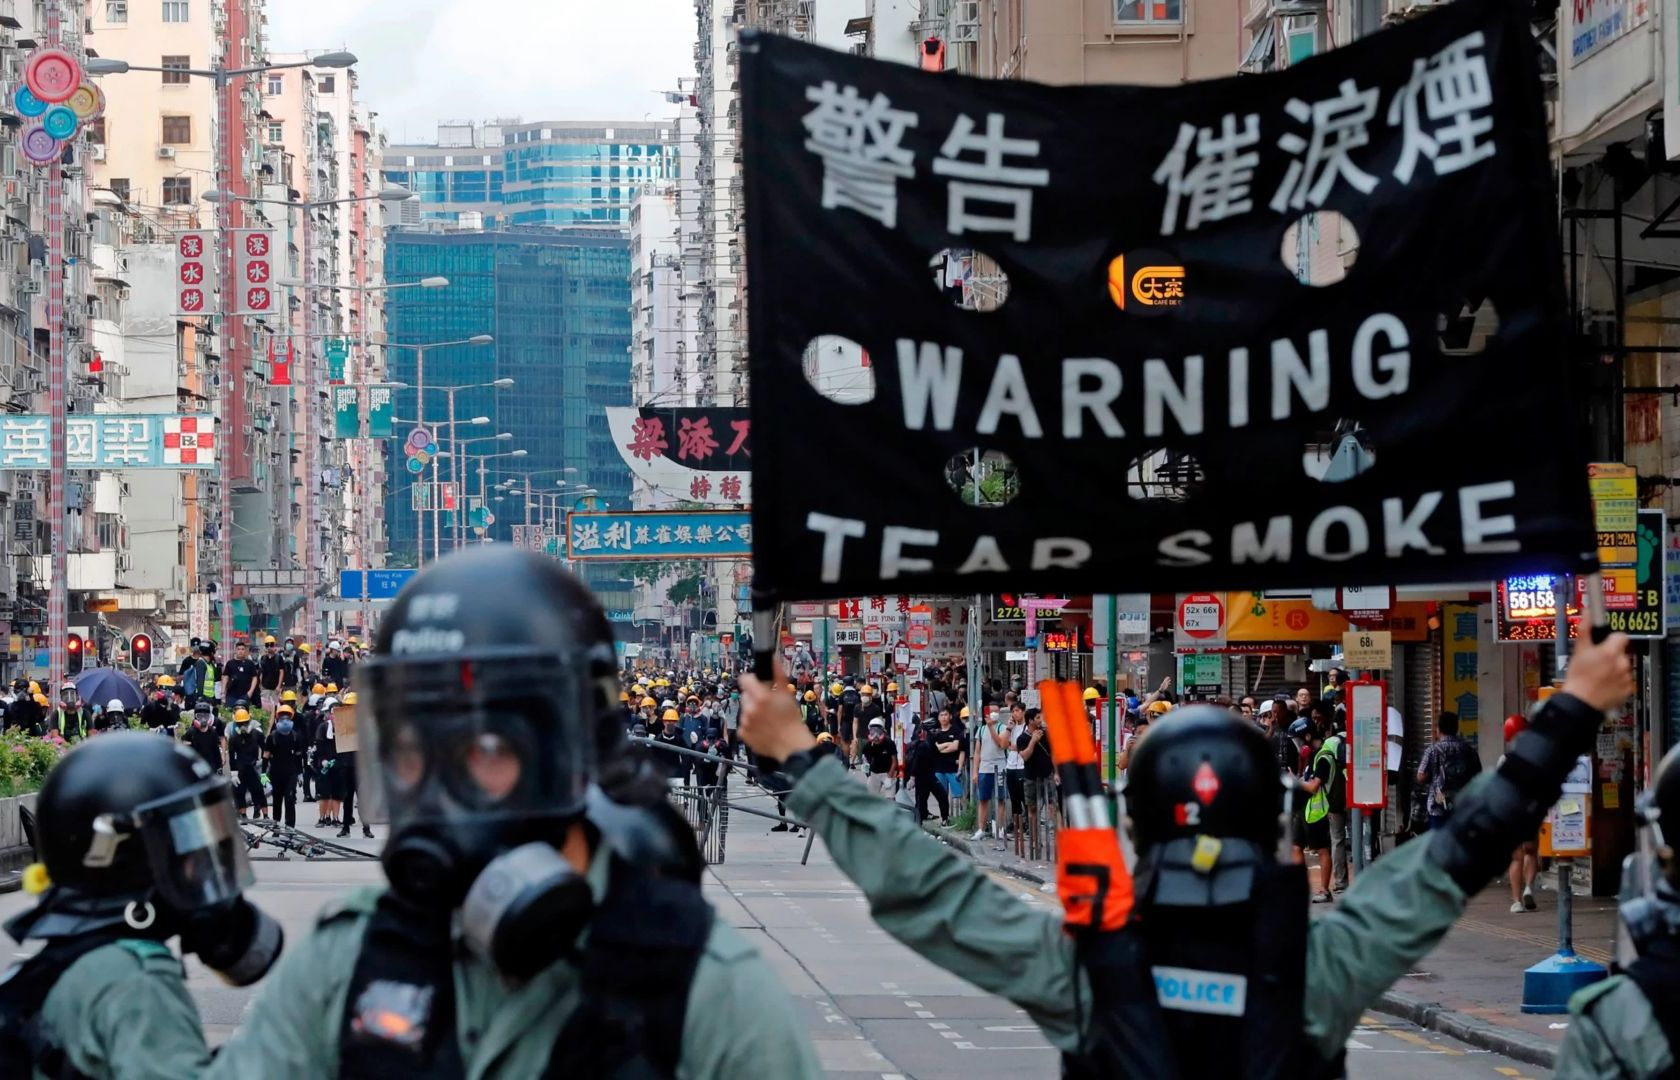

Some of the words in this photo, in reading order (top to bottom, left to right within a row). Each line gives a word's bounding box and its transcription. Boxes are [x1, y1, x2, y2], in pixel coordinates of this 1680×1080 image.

[802, 80, 1050, 242] 警告
[1152, 30, 1496, 236] 催淚煙
[896, 312, 1410, 439] WARNING
[690, 475, 742, 500] 特種
[1157, 480, 1521, 566] SMOKE
[1510, 591, 1555, 608] 56158
[1629, 612, 1658, 631] 6625
